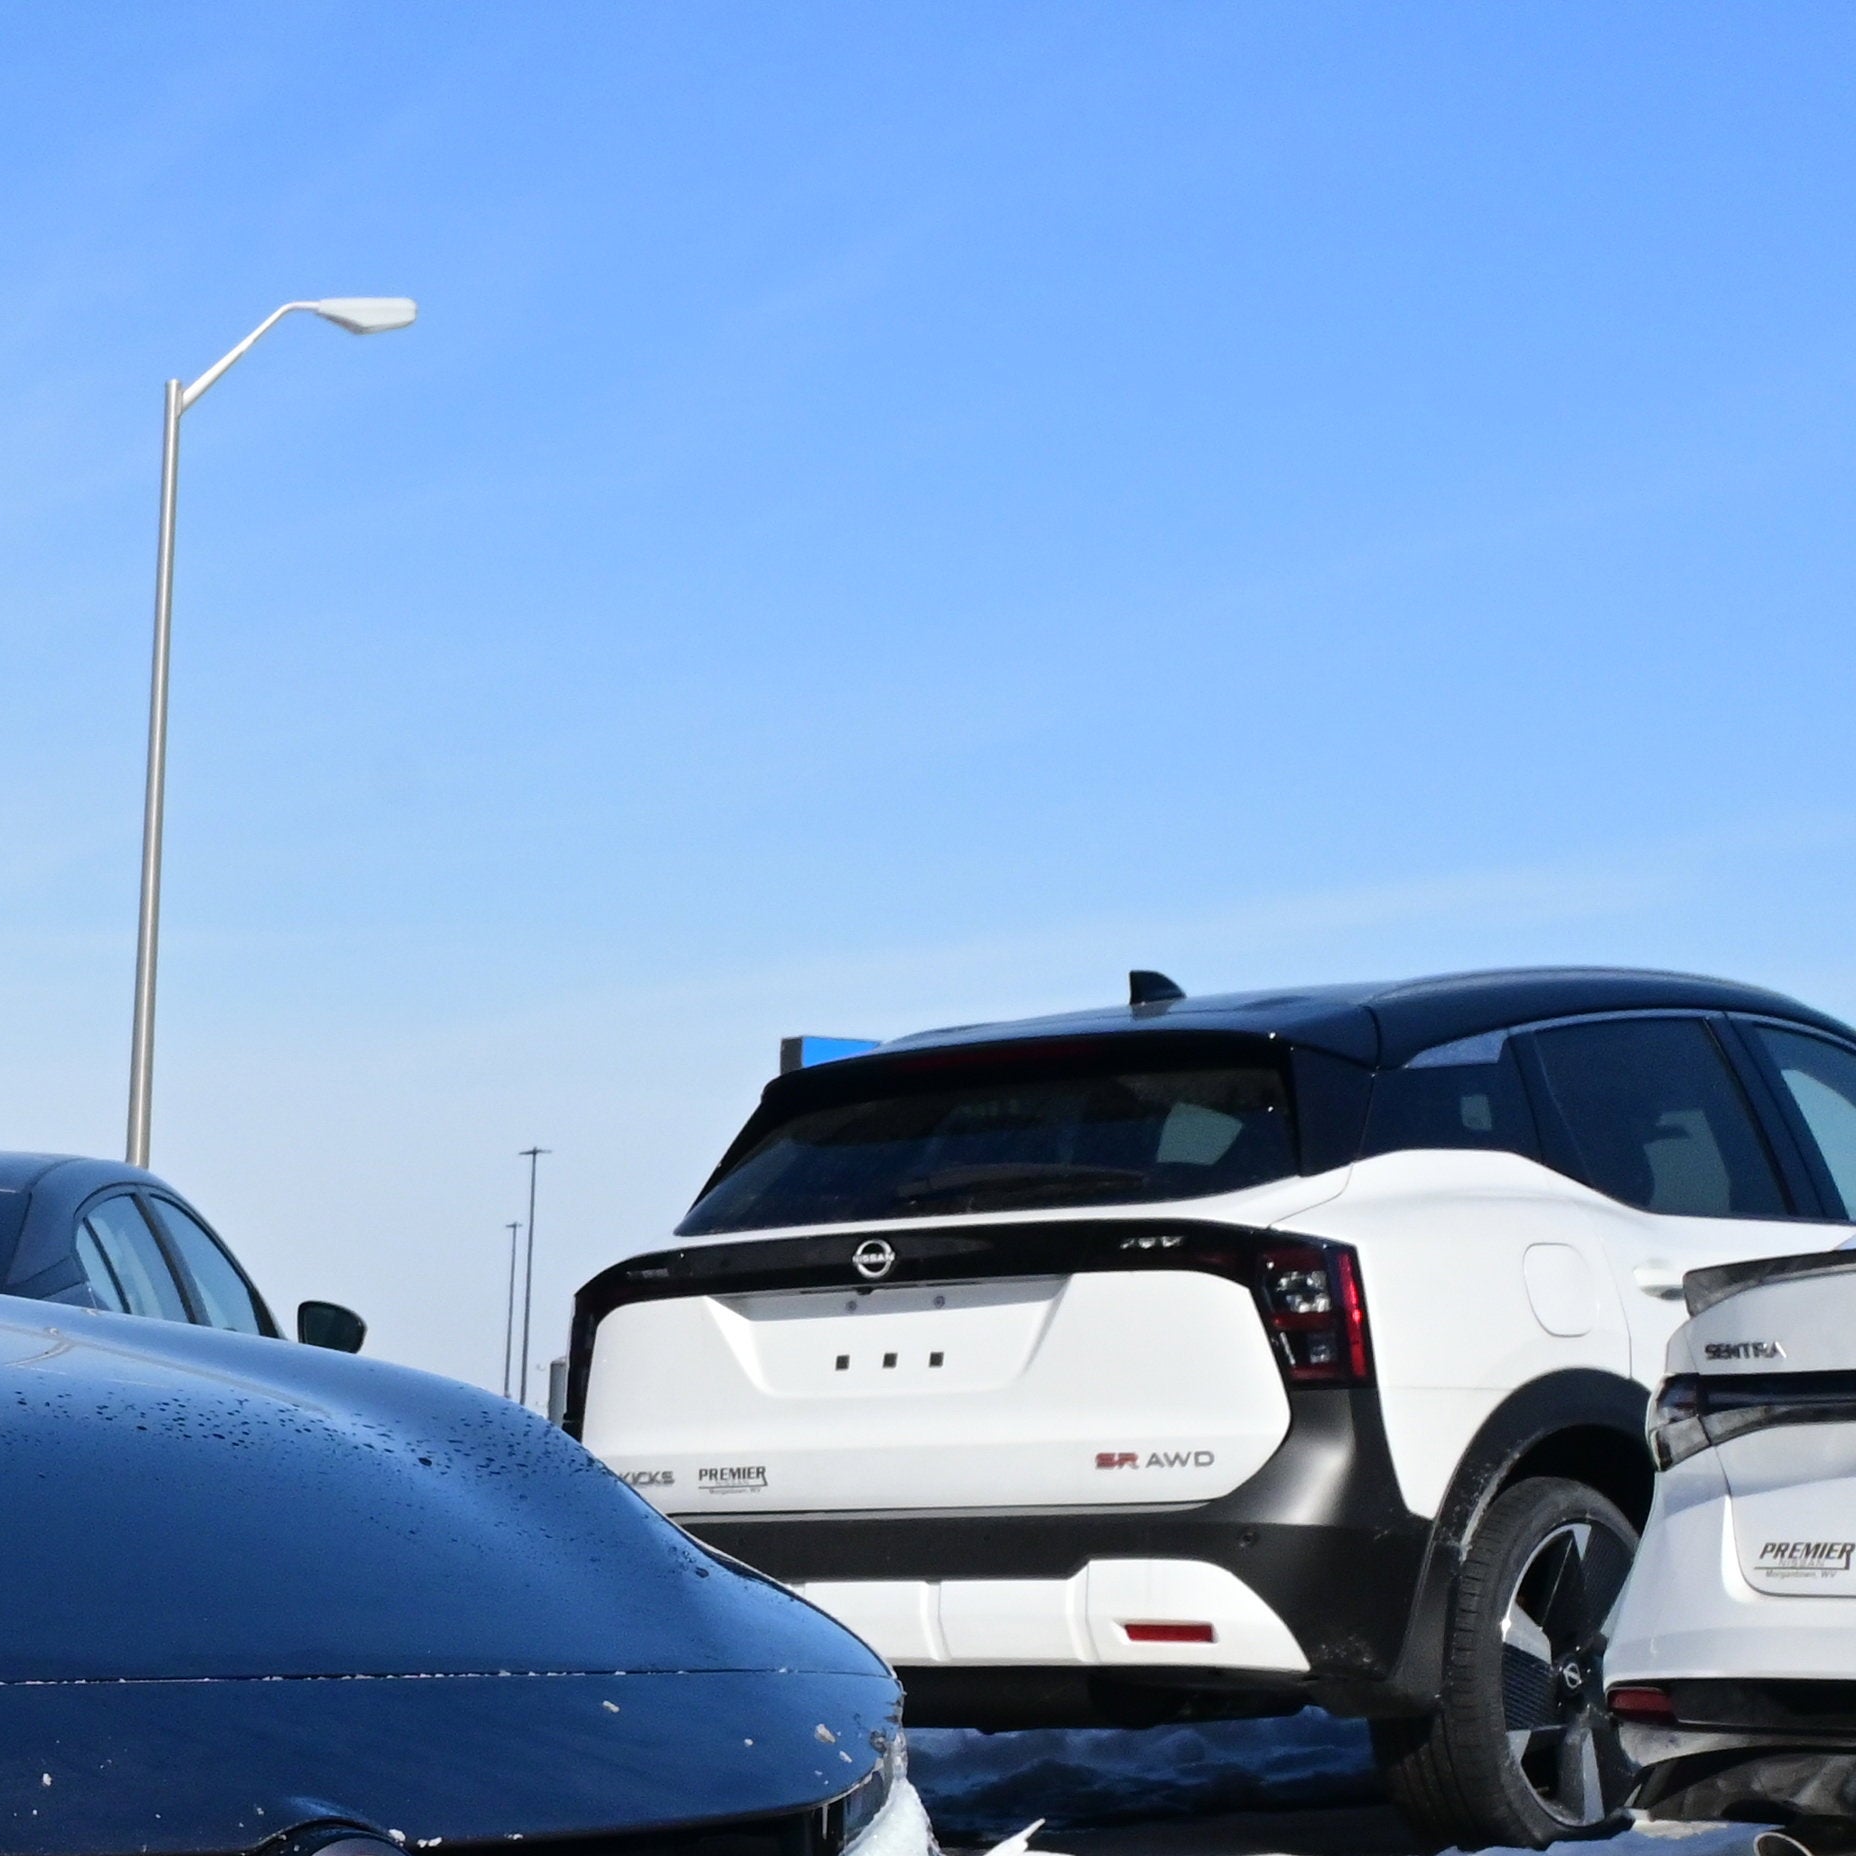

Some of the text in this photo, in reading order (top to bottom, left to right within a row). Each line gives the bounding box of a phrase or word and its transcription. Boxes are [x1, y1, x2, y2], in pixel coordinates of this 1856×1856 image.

[852, 1251, 896, 1265] NISSAN
[1704, 1340, 1787, 1361] SENTRA
[1095, 1450, 1215, 1469] SR AWD
[697, 1465, 767, 1484] PREMIER
[1759, 1542, 1855, 1561] PREMIER
